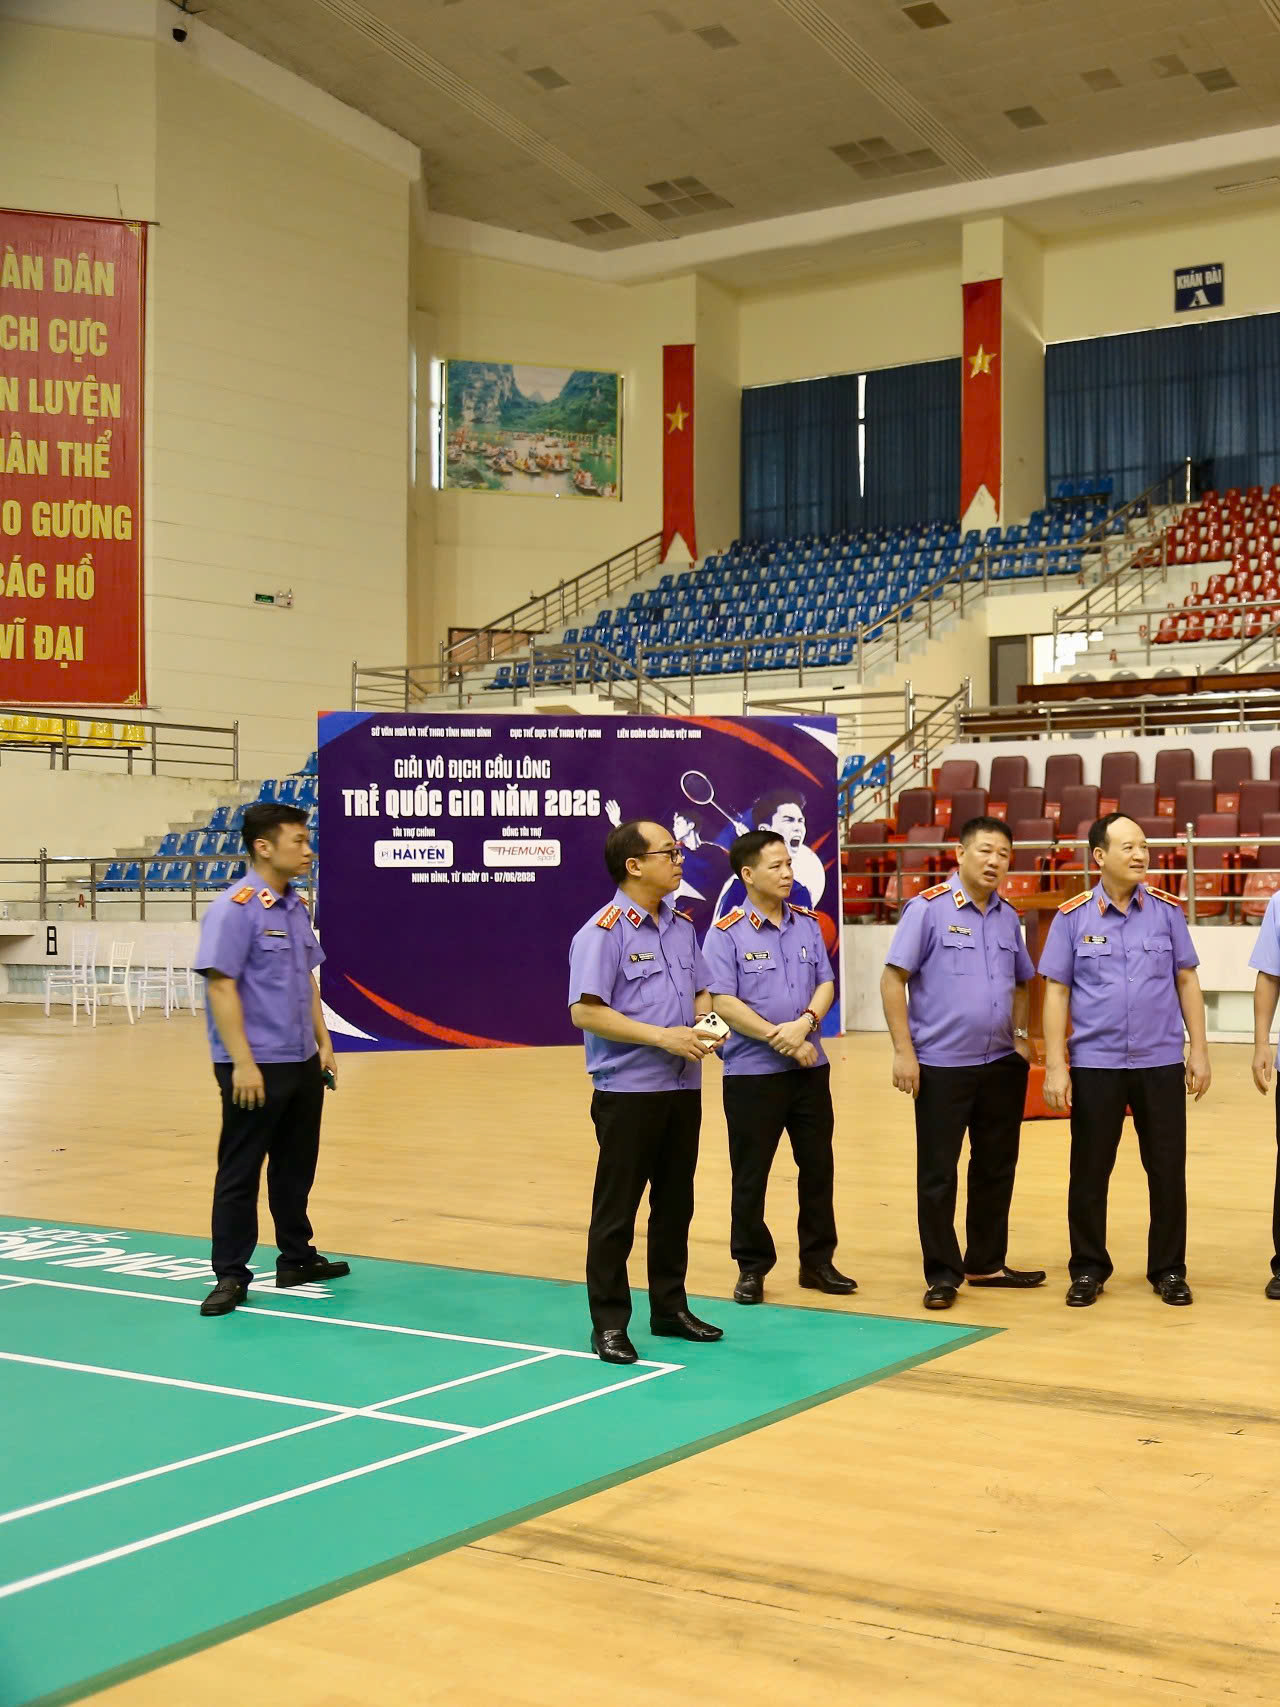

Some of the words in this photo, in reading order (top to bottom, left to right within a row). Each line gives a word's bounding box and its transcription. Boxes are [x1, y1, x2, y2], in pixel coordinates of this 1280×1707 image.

[0, 245, 43, 291] ÀN
[54, 252, 115, 297] DÂN
[1189, 289, 1210, 307] A
[0, 314, 39, 352] CH
[48, 317, 108, 363] CỰC
[28, 374, 121, 425] LUYỆN
[0, 431, 48, 476] ÂN
[57, 429, 113, 478] THỂ
[32, 499, 133, 541] GƯƠNG
[56, 553, 95, 601] HỒ
[34, 624, 84, 669] ĐẠI
[394, 754, 423, 779] GIẢI
[426, 754, 445, 779] VÔ
[448, 758, 482, 783] ĐỊCH
[484, 753, 513, 779] CẦU
[516, 755, 551, 779] LÔNG
[341, 783, 380, 817] TRẺ
[385, 780, 443, 819] QUỐC
[448, 789, 485, 817] GIA
[491, 783, 539, 817] NĂM
[544, 789, 601, 817] 2026
[393, 844, 416, 860] HẢI
[418, 845, 445, 860] YẾN
[488, 846, 556, 856] THEMUNG
[411, 872, 430, 883] NINH
